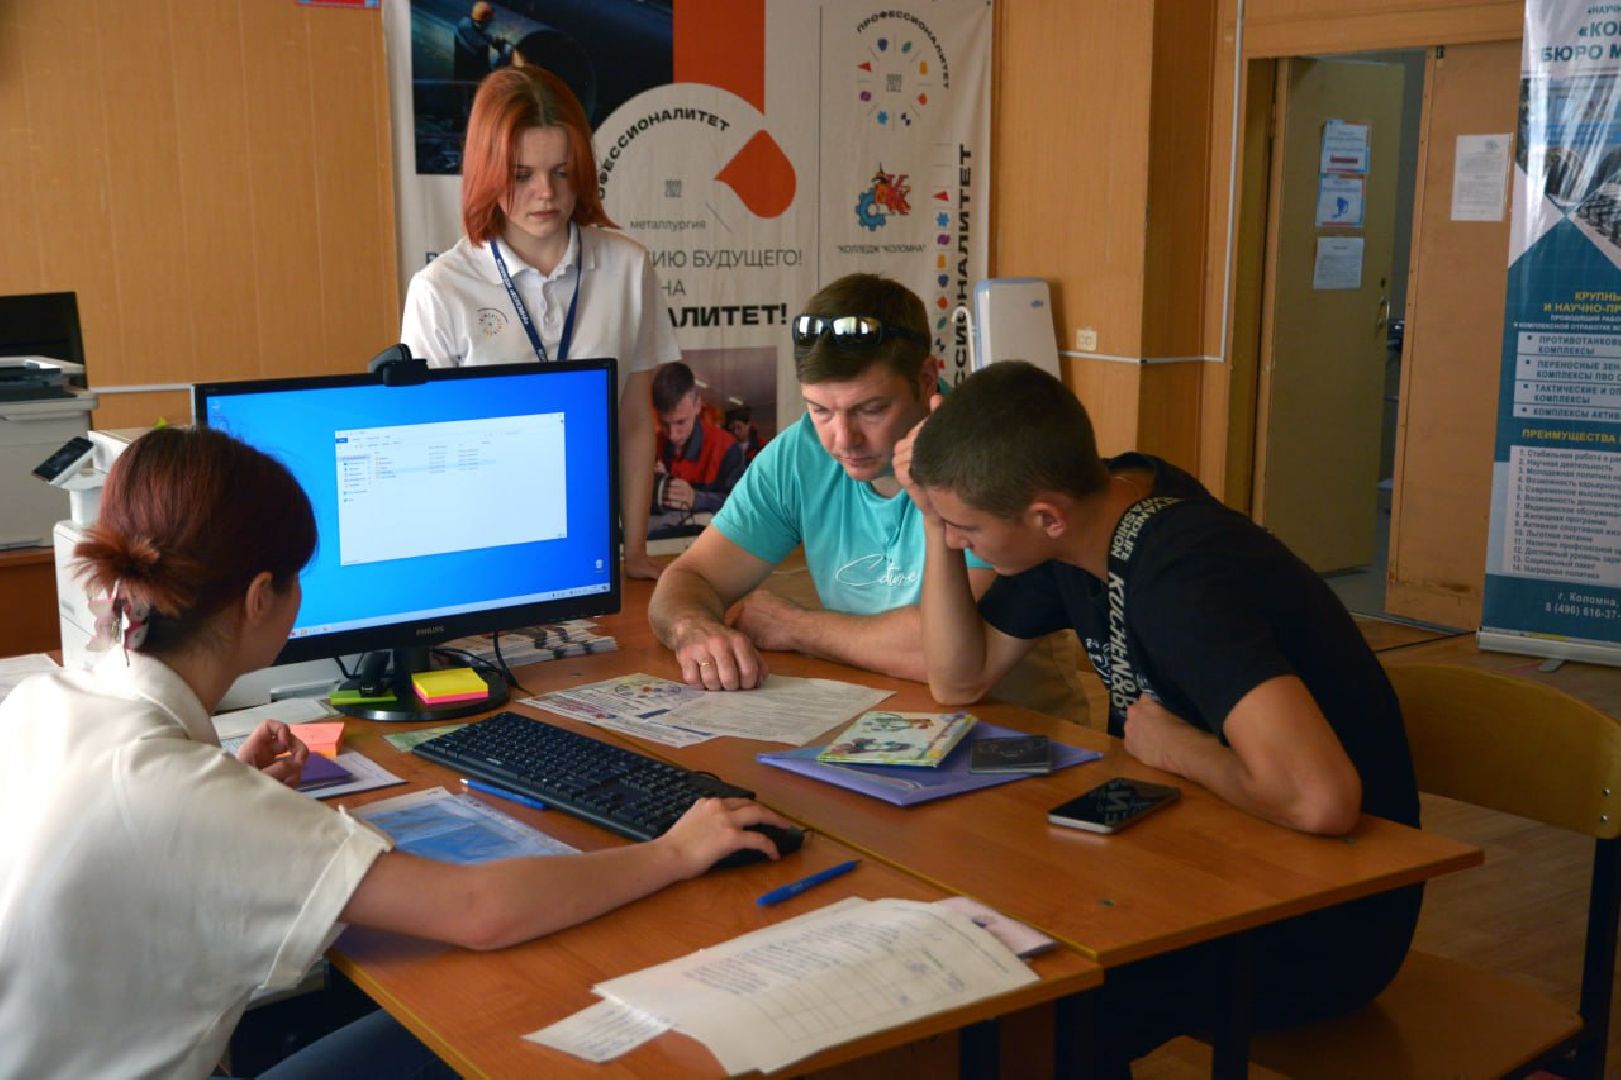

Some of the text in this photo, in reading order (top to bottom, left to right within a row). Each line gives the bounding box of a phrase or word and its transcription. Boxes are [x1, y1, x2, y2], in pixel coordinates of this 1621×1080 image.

[857, 10, 949, 90] ПРОФЕССИОНАЛИТЕТ
[1541, 45, 1604, 62] БЮРО
[630, 219, 707, 232] металлургия
[692, 249, 802, 269] БУДУЩЕГО!
[1543, 302, 1552, 313] И
[1538, 345, 1595, 355] КОМПЛЕКСЫ
[1537, 359, 1600, 370] ПЕРЕНОСНЫЕ
[1536, 370, 1592, 380] КОМПЛЕКСЫ
[1535, 383, 1599, 394] ТАКТИЧЕСКИЕ
[1533, 394, 1591, 404] КОМПЛЕКСЫ
[1532, 407, 1590, 418] КОМПЛЕКСЫ
[1522, 428, 1616, 444] ПРЕИМУЩЕСТВА
[1545, 601, 1552, 612] 8
